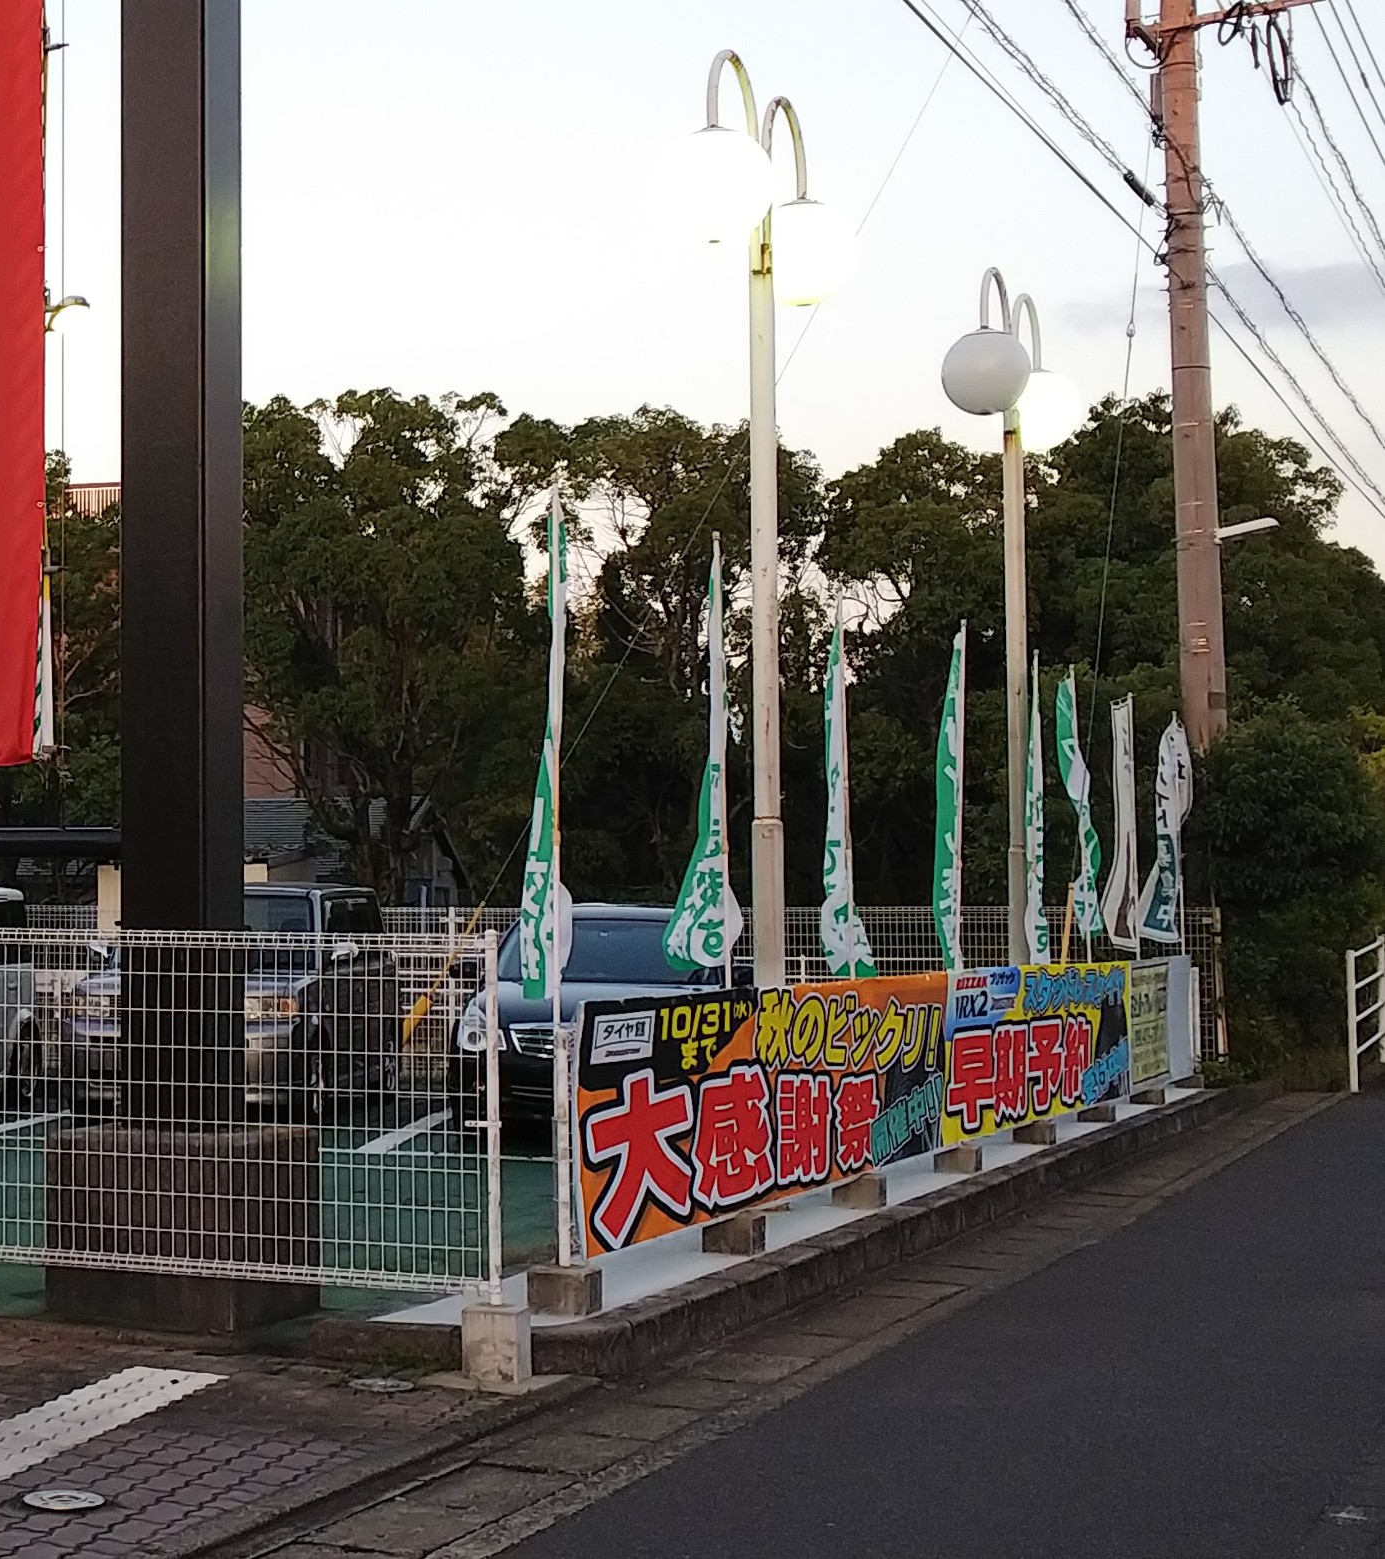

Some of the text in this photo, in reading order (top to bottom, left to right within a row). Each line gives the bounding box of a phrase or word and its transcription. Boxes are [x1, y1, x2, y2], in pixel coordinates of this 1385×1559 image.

[681, 1037, 717, 1071] まで
[588, 1068, 880, 1247] 大感謝祭
